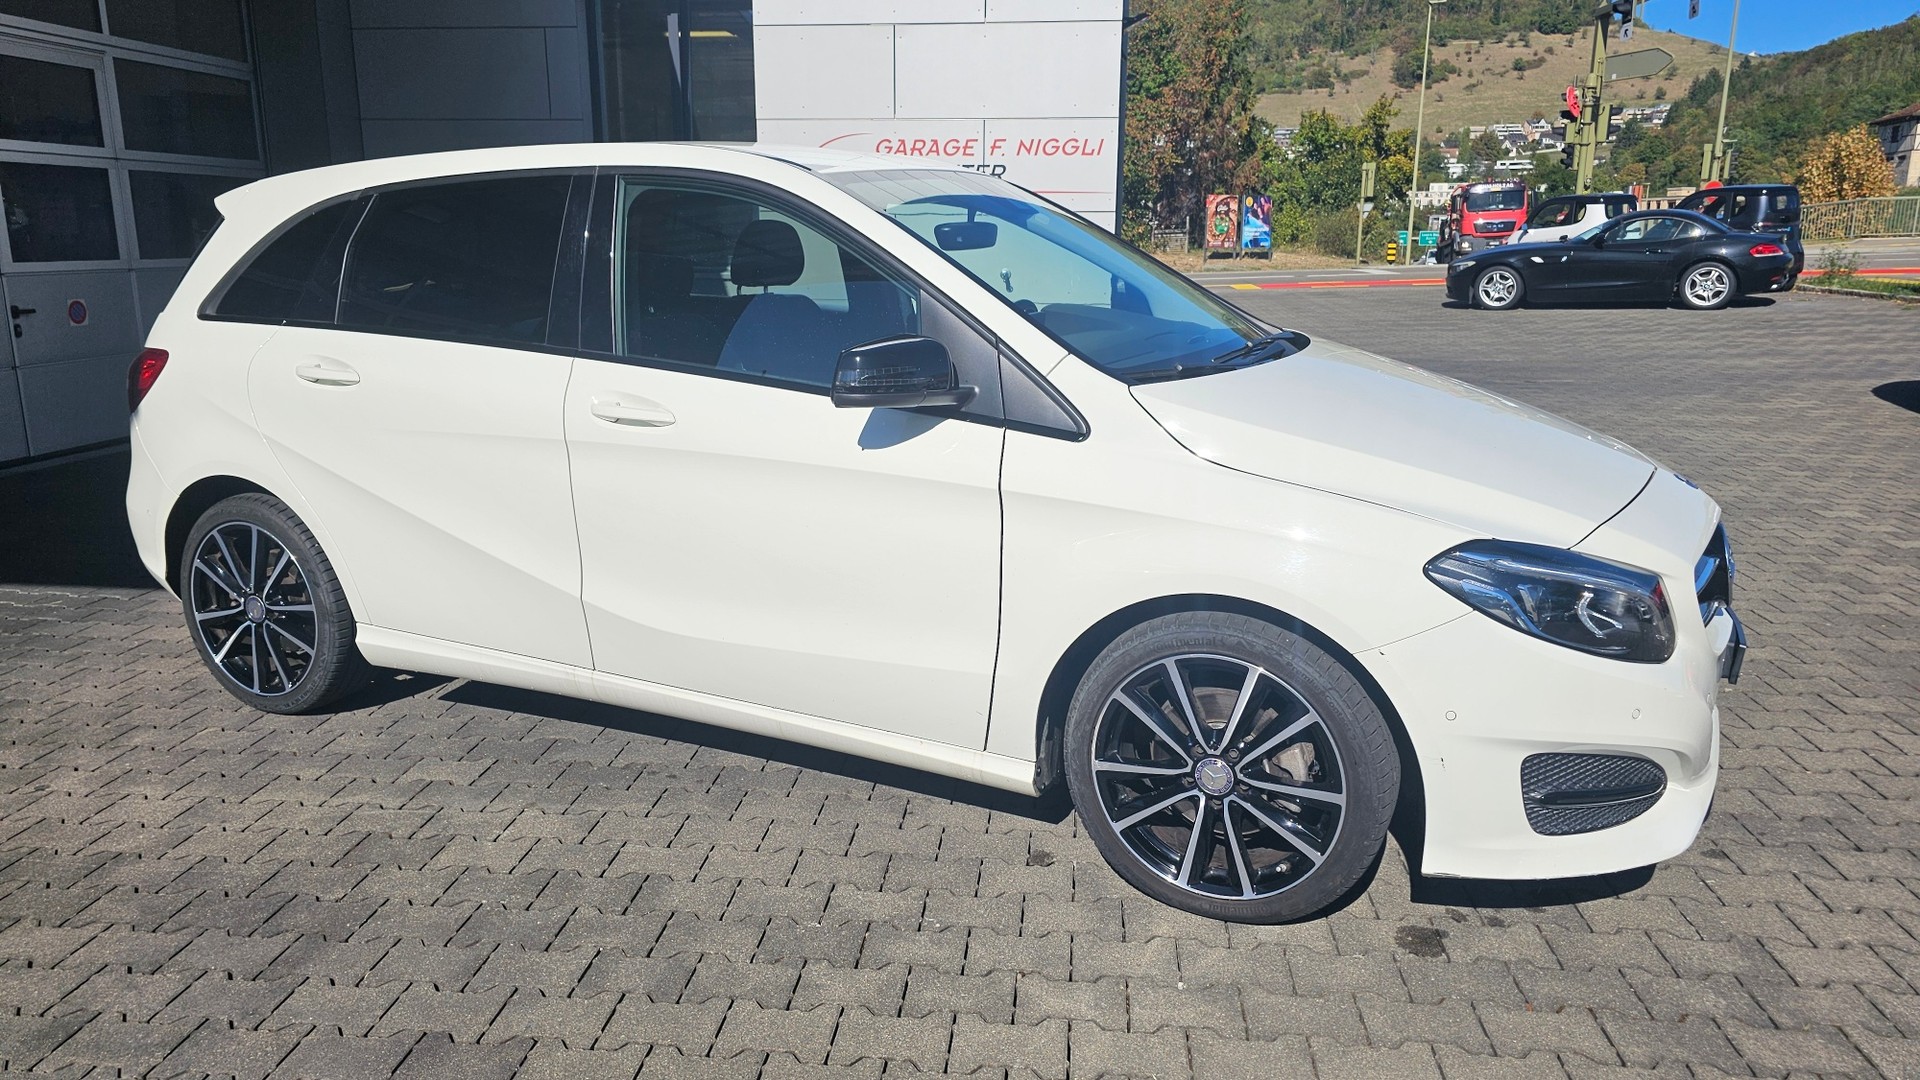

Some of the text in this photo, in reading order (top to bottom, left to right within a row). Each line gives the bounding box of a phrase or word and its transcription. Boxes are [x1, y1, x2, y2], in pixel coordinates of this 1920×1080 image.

[875, 138, 1105, 157] GARAGE F. NIGGLI
